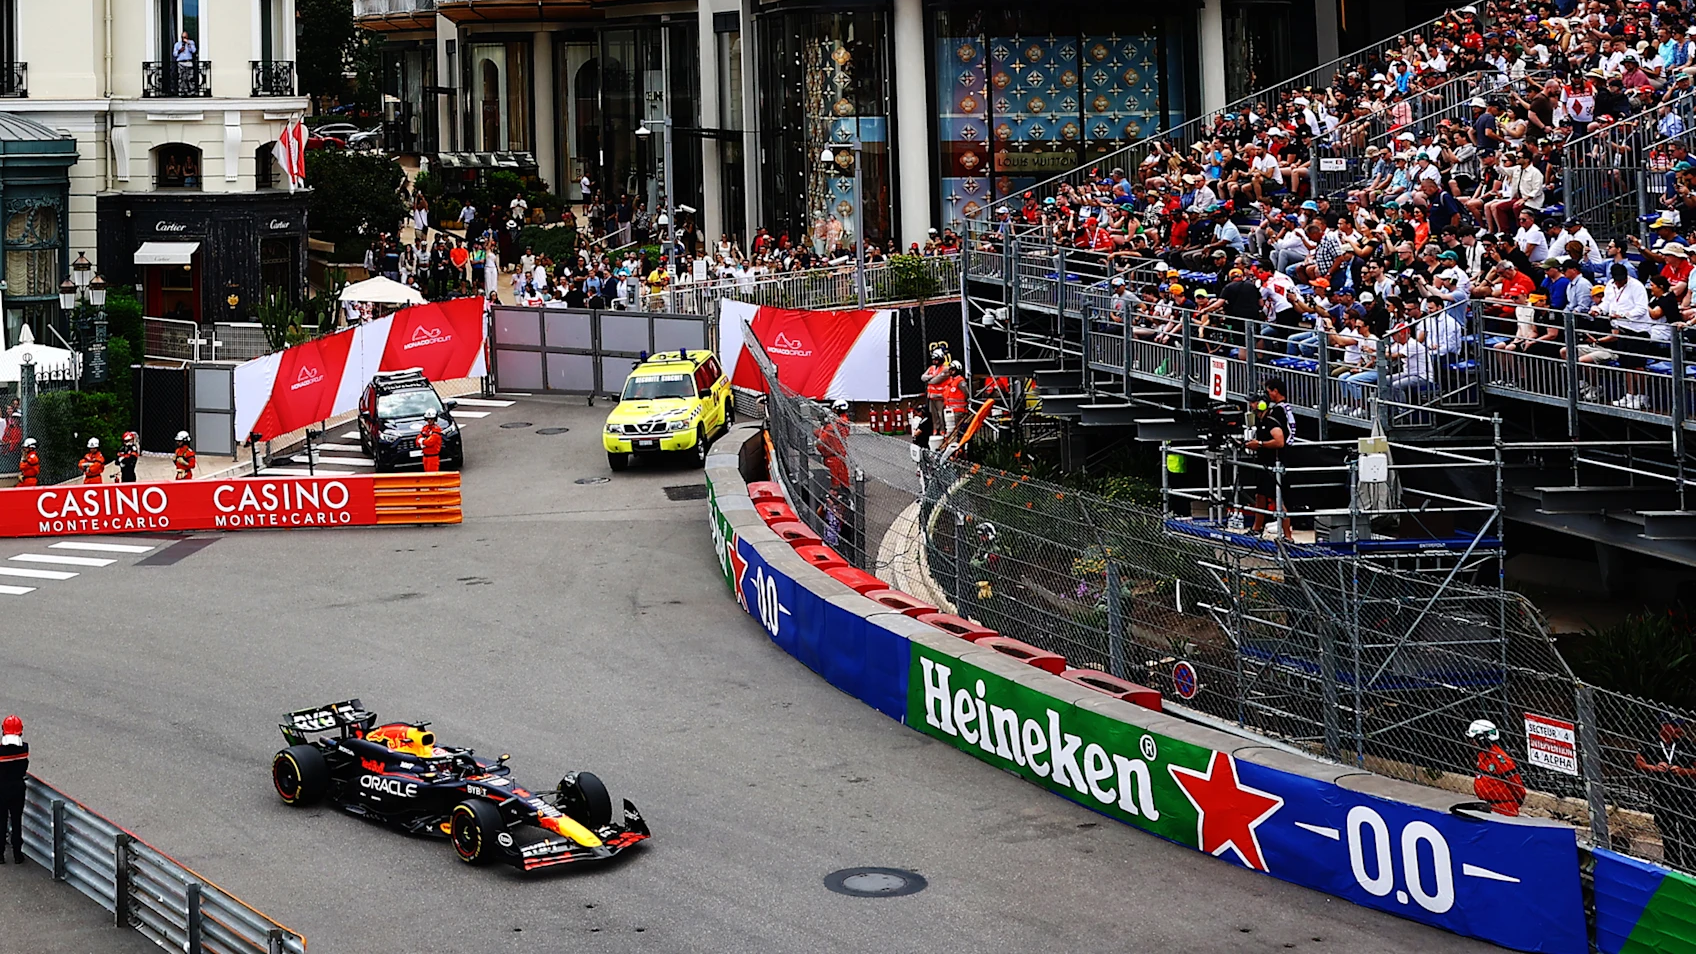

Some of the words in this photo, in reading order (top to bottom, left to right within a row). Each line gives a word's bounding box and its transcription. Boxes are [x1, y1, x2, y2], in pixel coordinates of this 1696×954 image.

[999, 157, 1029, 167] LOUIS
[1032, 157, 1077, 166] VUITTON
[155, 220, 186, 232] Cartier
[270, 219, 290, 229] Cartier
[1214, 373, 1222, 396] B
[37, 486, 167, 519] CASINO
[214, 481, 349, 513] CASINO
[39, 519, 101, 532] MONTE
[112, 515, 170, 528] CARLO
[215, 514, 278, 526] MONTE
[289, 511, 351, 524] CARLO
[1529, 723, 1557, 738] SECTEUR
[1563, 732, 1569, 740] 4
[1534, 751, 1540, 760] 4
[1544, 754, 1572, 768] ALPHA
[360, 775, 418, 798] ORACLE
[1346, 805, 1454, 914] 0.0
